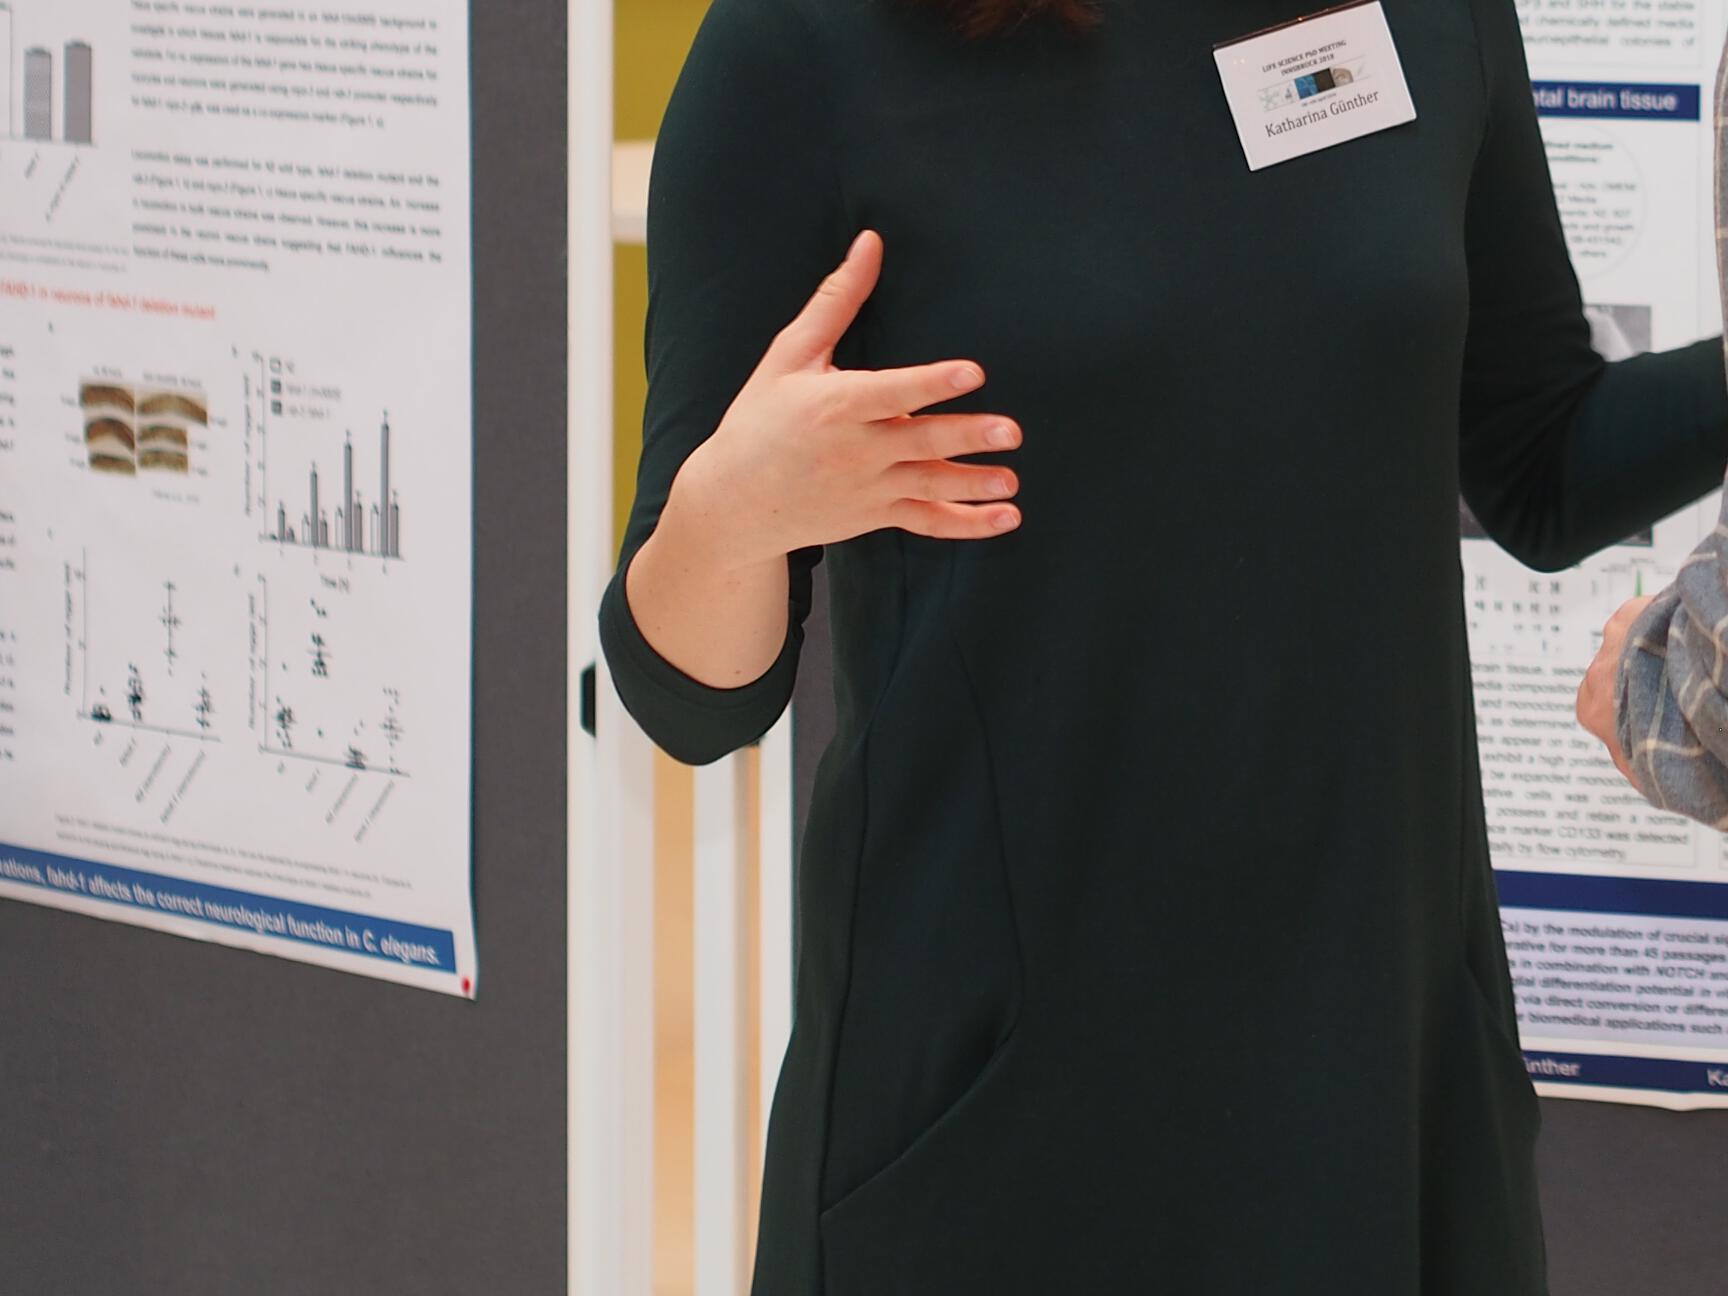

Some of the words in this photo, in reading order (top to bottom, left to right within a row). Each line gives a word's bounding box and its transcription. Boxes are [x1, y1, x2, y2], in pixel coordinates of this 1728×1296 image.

[1265, 108, 1328, 137] Katharina
[1329, 90, 1380, 117] Günther
[1567, 89, 1616, 109] brain
[1620, 90, 1677, 111] tissue
[88, 874, 131, 902] affects
[133, 882, 155, 906] the
[156, 892, 202, 916] correct
[204, 899, 287, 935] neurological
[287, 912, 344, 945] function
[346, 924, 360, 946] in
